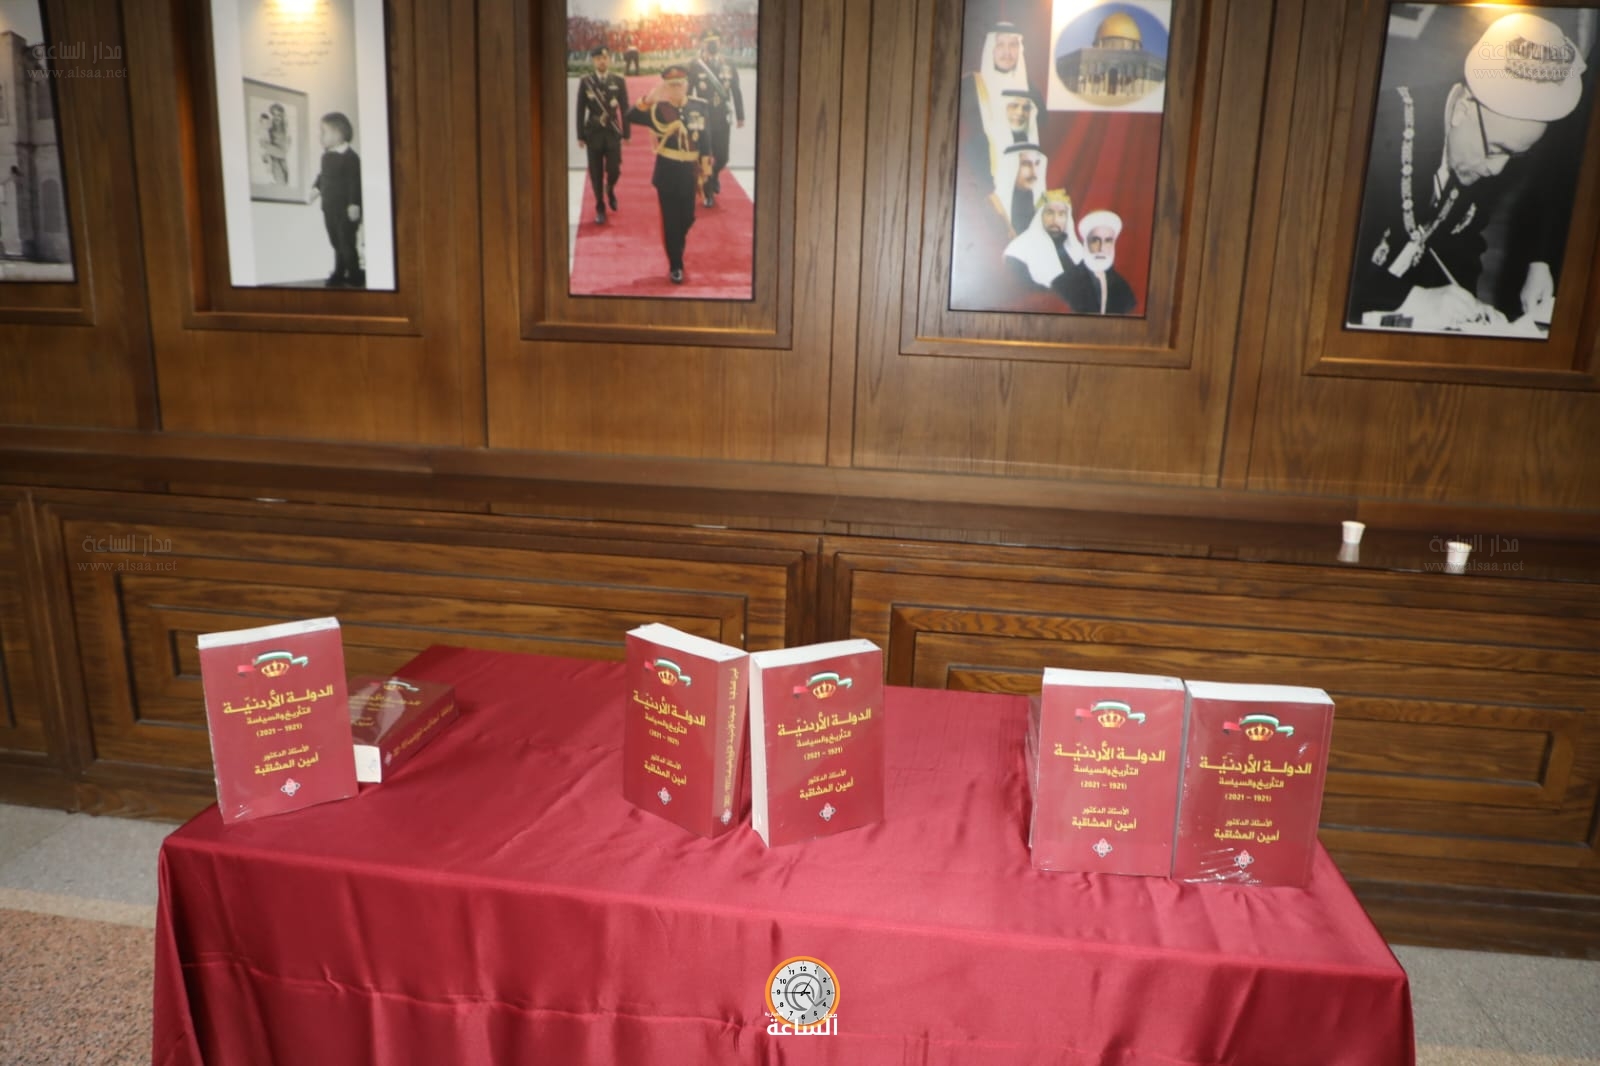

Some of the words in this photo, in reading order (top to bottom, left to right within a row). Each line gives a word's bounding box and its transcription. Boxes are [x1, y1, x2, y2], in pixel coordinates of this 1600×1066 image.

[286, 684, 334, 703] الدولة
[671, 704, 706, 727] الدولة
[831, 707, 872, 726] الدولة
[1116, 747, 1166, 764] الدولة
[1262, 760, 1312, 776] الدولة
